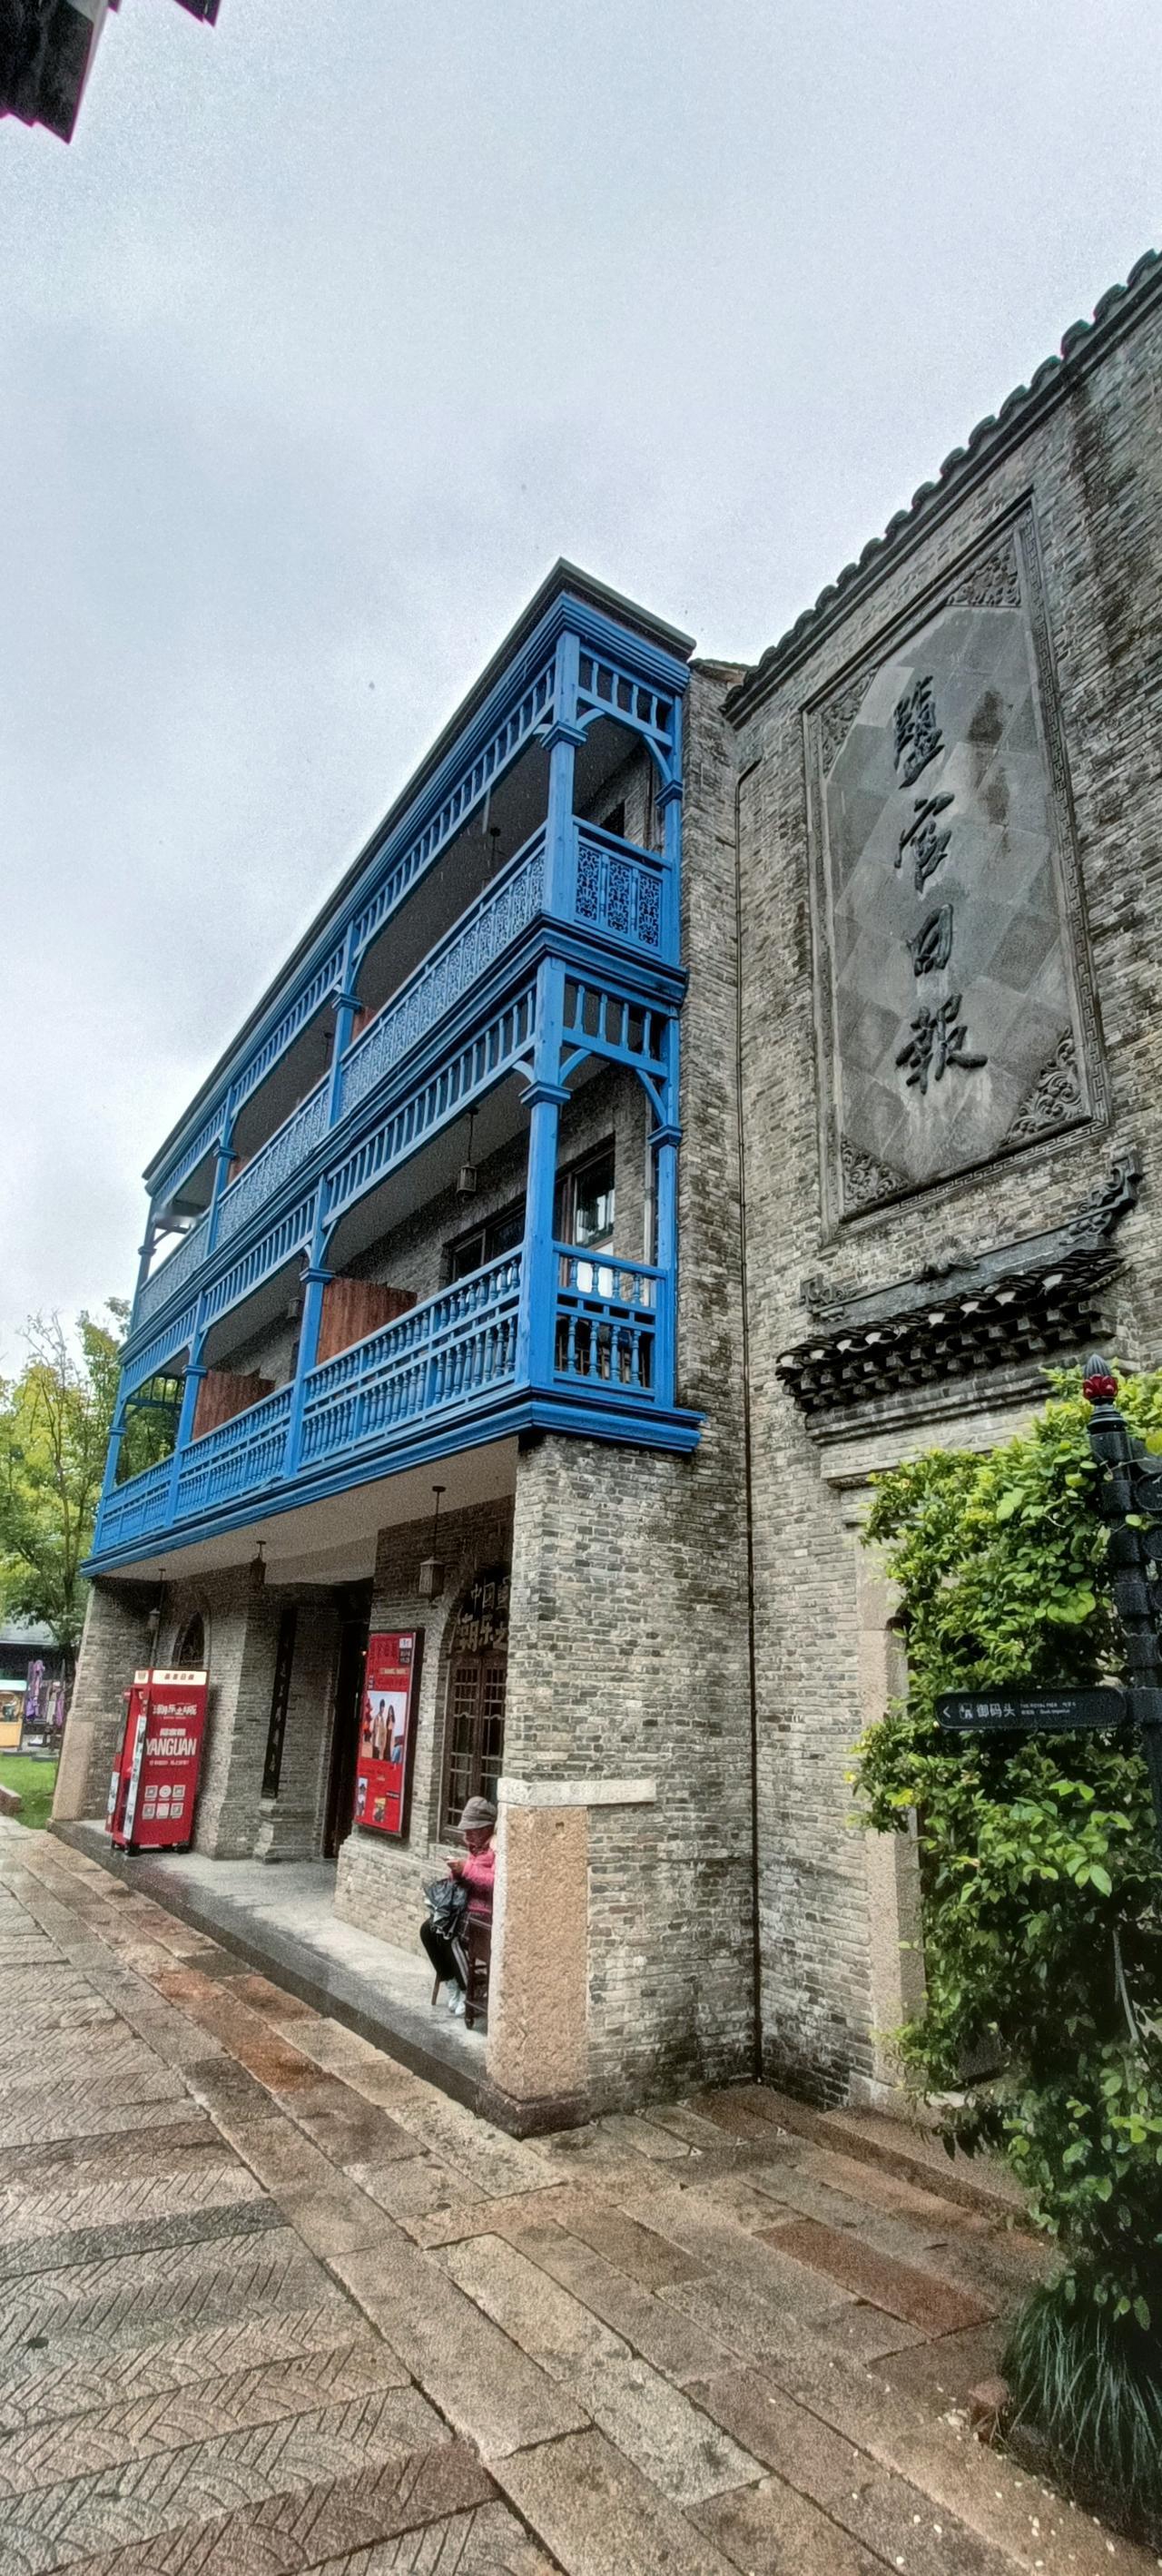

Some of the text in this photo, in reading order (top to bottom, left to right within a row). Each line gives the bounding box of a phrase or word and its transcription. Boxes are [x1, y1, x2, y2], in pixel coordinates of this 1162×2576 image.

[976, 1703, 1016, 1718] 御码头
[145, 1737, 197, 1756] YANGUAN
